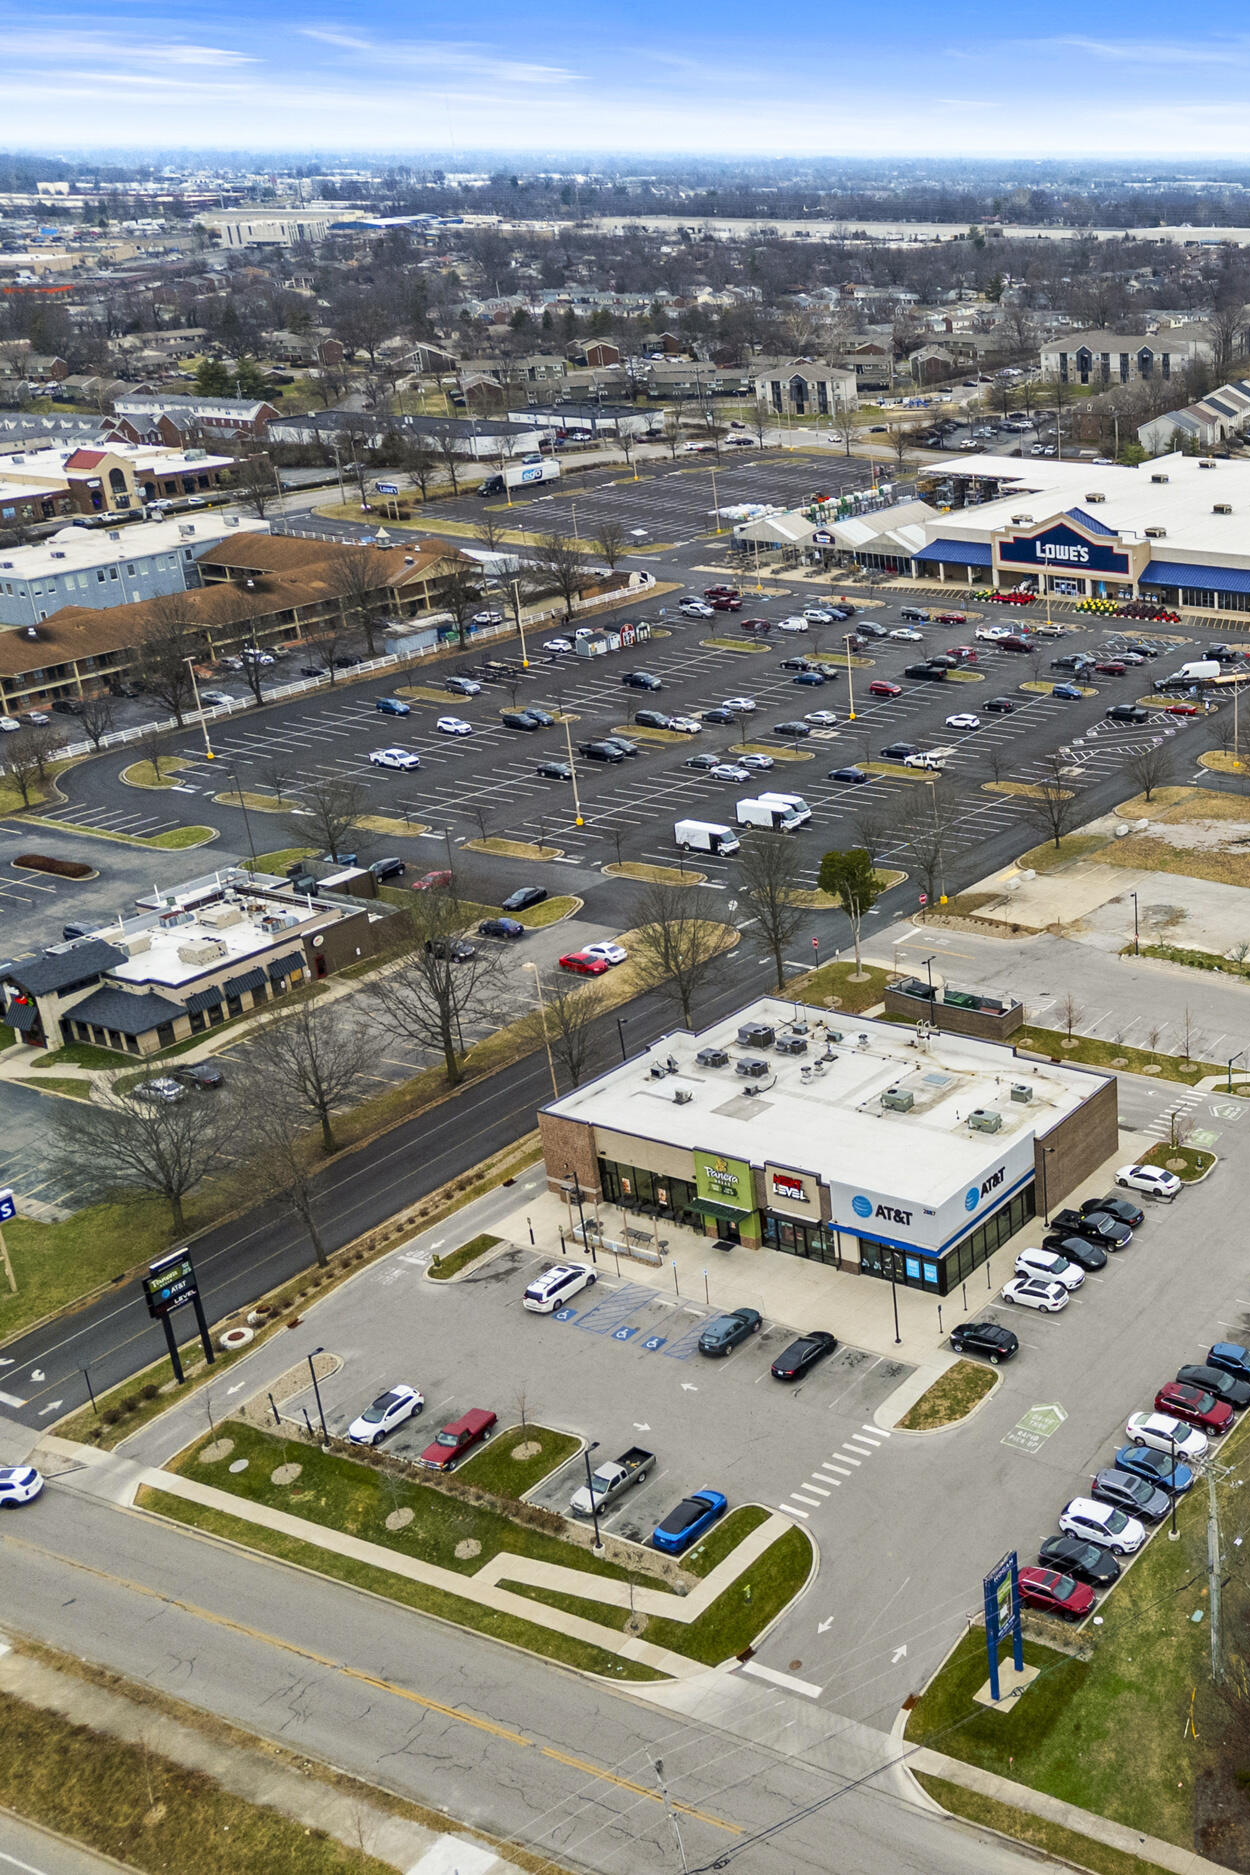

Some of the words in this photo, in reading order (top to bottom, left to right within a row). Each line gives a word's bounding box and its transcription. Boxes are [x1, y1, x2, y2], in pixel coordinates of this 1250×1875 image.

[1035, 540, 1090, 562] LOWE'S
[703, 1166, 739, 1184] Panera
[772, 1173, 802, 1190] NEXT
[980, 1166, 1006, 1199] AT&T
[772, 1183, 807, 1200] LEVEL
[875, 1204, 913, 1226] AT&T
